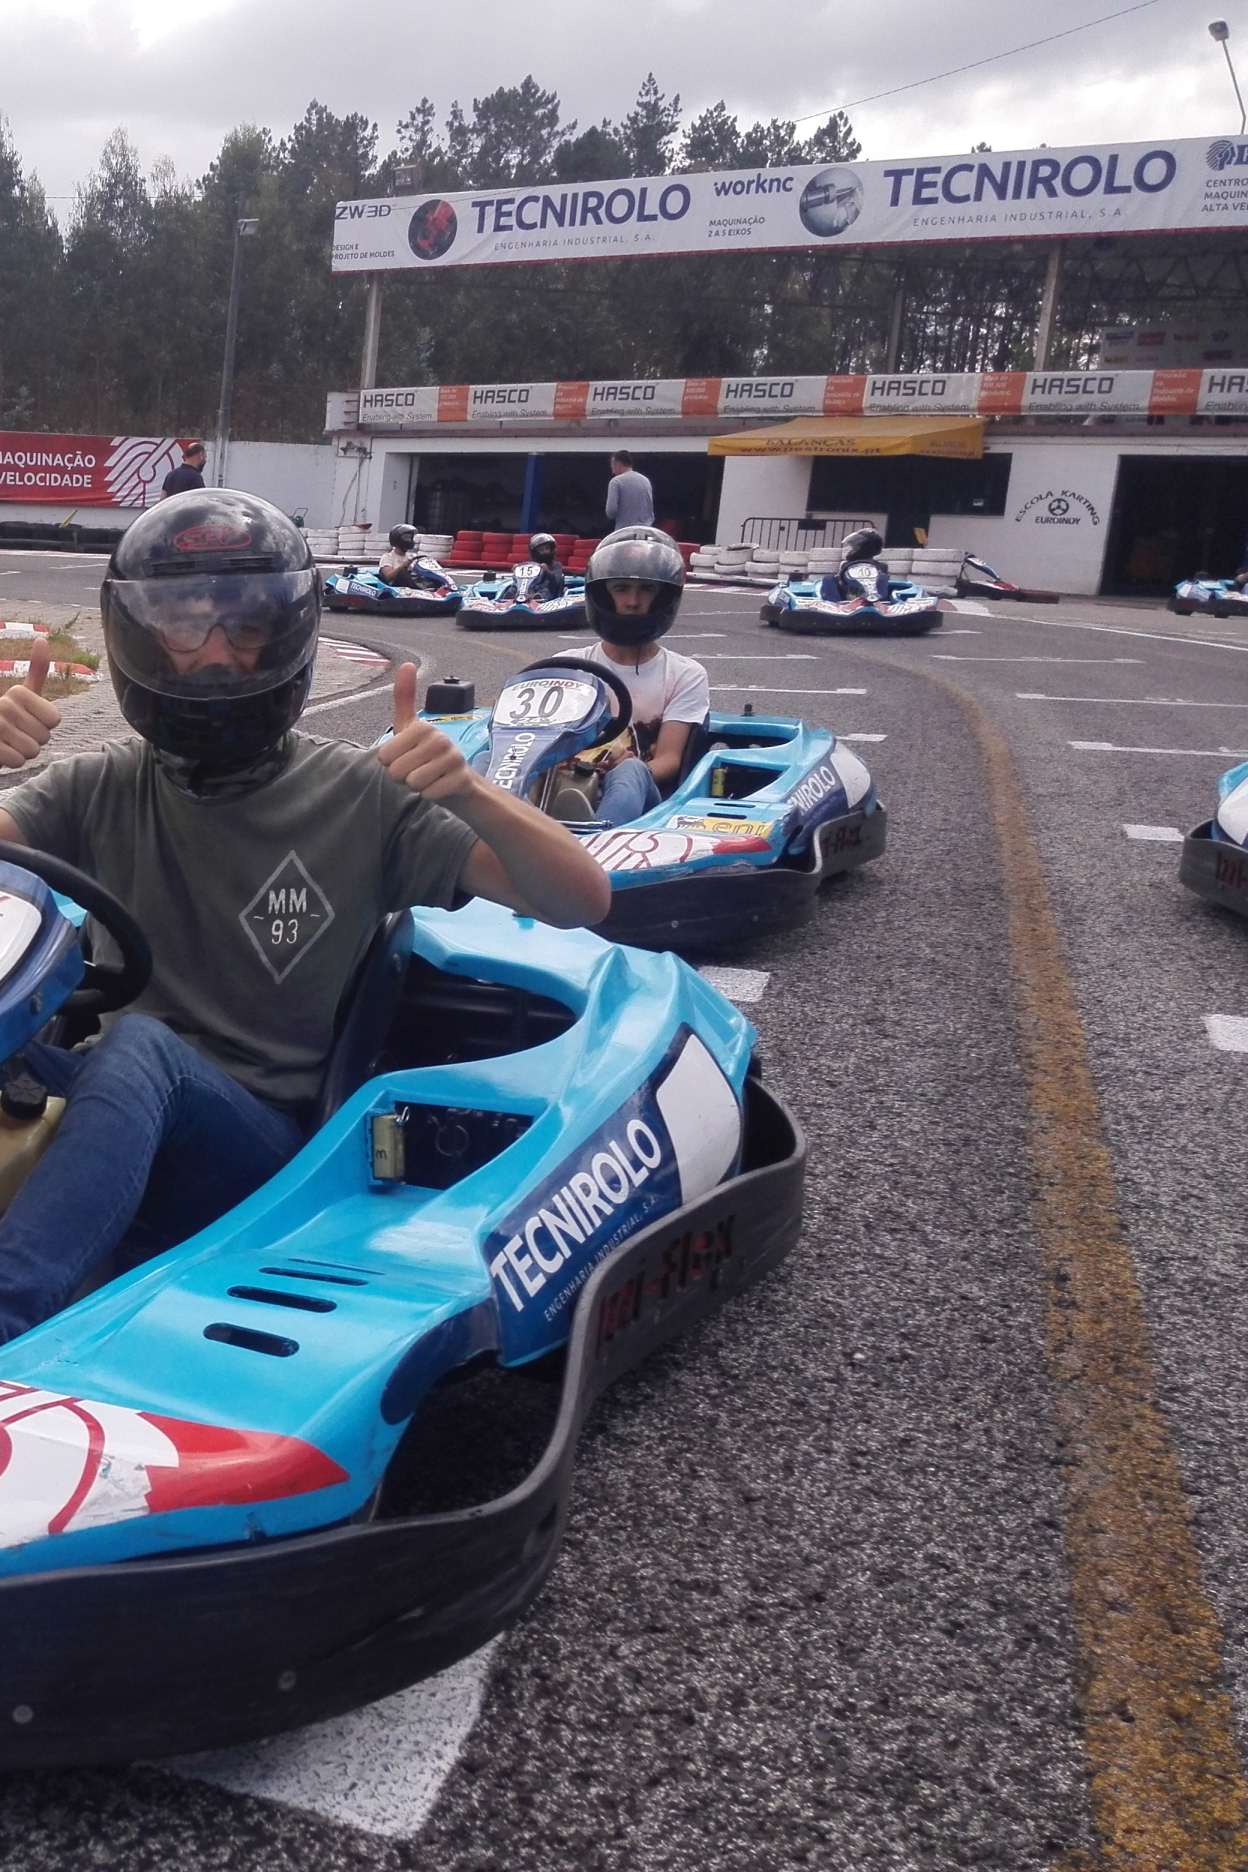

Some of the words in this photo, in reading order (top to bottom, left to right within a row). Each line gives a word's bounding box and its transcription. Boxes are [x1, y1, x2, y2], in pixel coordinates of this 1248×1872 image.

[713, 172, 794, 197] worknc
[883, 150, 1177, 208] TECNIROLO
[334, 205, 392, 220] ZW3D
[471, 183, 691, 234] TECNIROLO
[1200, 202, 1229, 212] ALTA
[913, 214, 997, 227] ENGENHARIA
[494, 238, 559, 251] ENGENHARIA
[593, 385, 655, 401] HASCO
[726, 382, 795, 399] HASCO
[871, 379, 946, 396] HASCO
[1031, 377, 1114, 395] HASCO
[1208, 375, 1248, 394] HA
[363, 392, 415, 408] HASCO
[473, 388, 530, 404] HASCO
[1015, 490, 1053, 523] ESCOLA
[1060, 489, 1100, 526] KARTING
[1035, 516, 1080, 525] EUROINDY
[520, 566, 533, 577] 15
[512, 680, 584, 691] EUROINDY
[509, 687, 564, 719] 30
[493, 732, 535, 790] ECNIROLO
[788, 766, 836, 812] NIROLO
[268, 887, 307, 915] MM
[271, 918, 299, 945] 93
[490, 1118, 662, 1312] TECNIROLO
[544, 1261, 596, 1322] ENGENHARIA
